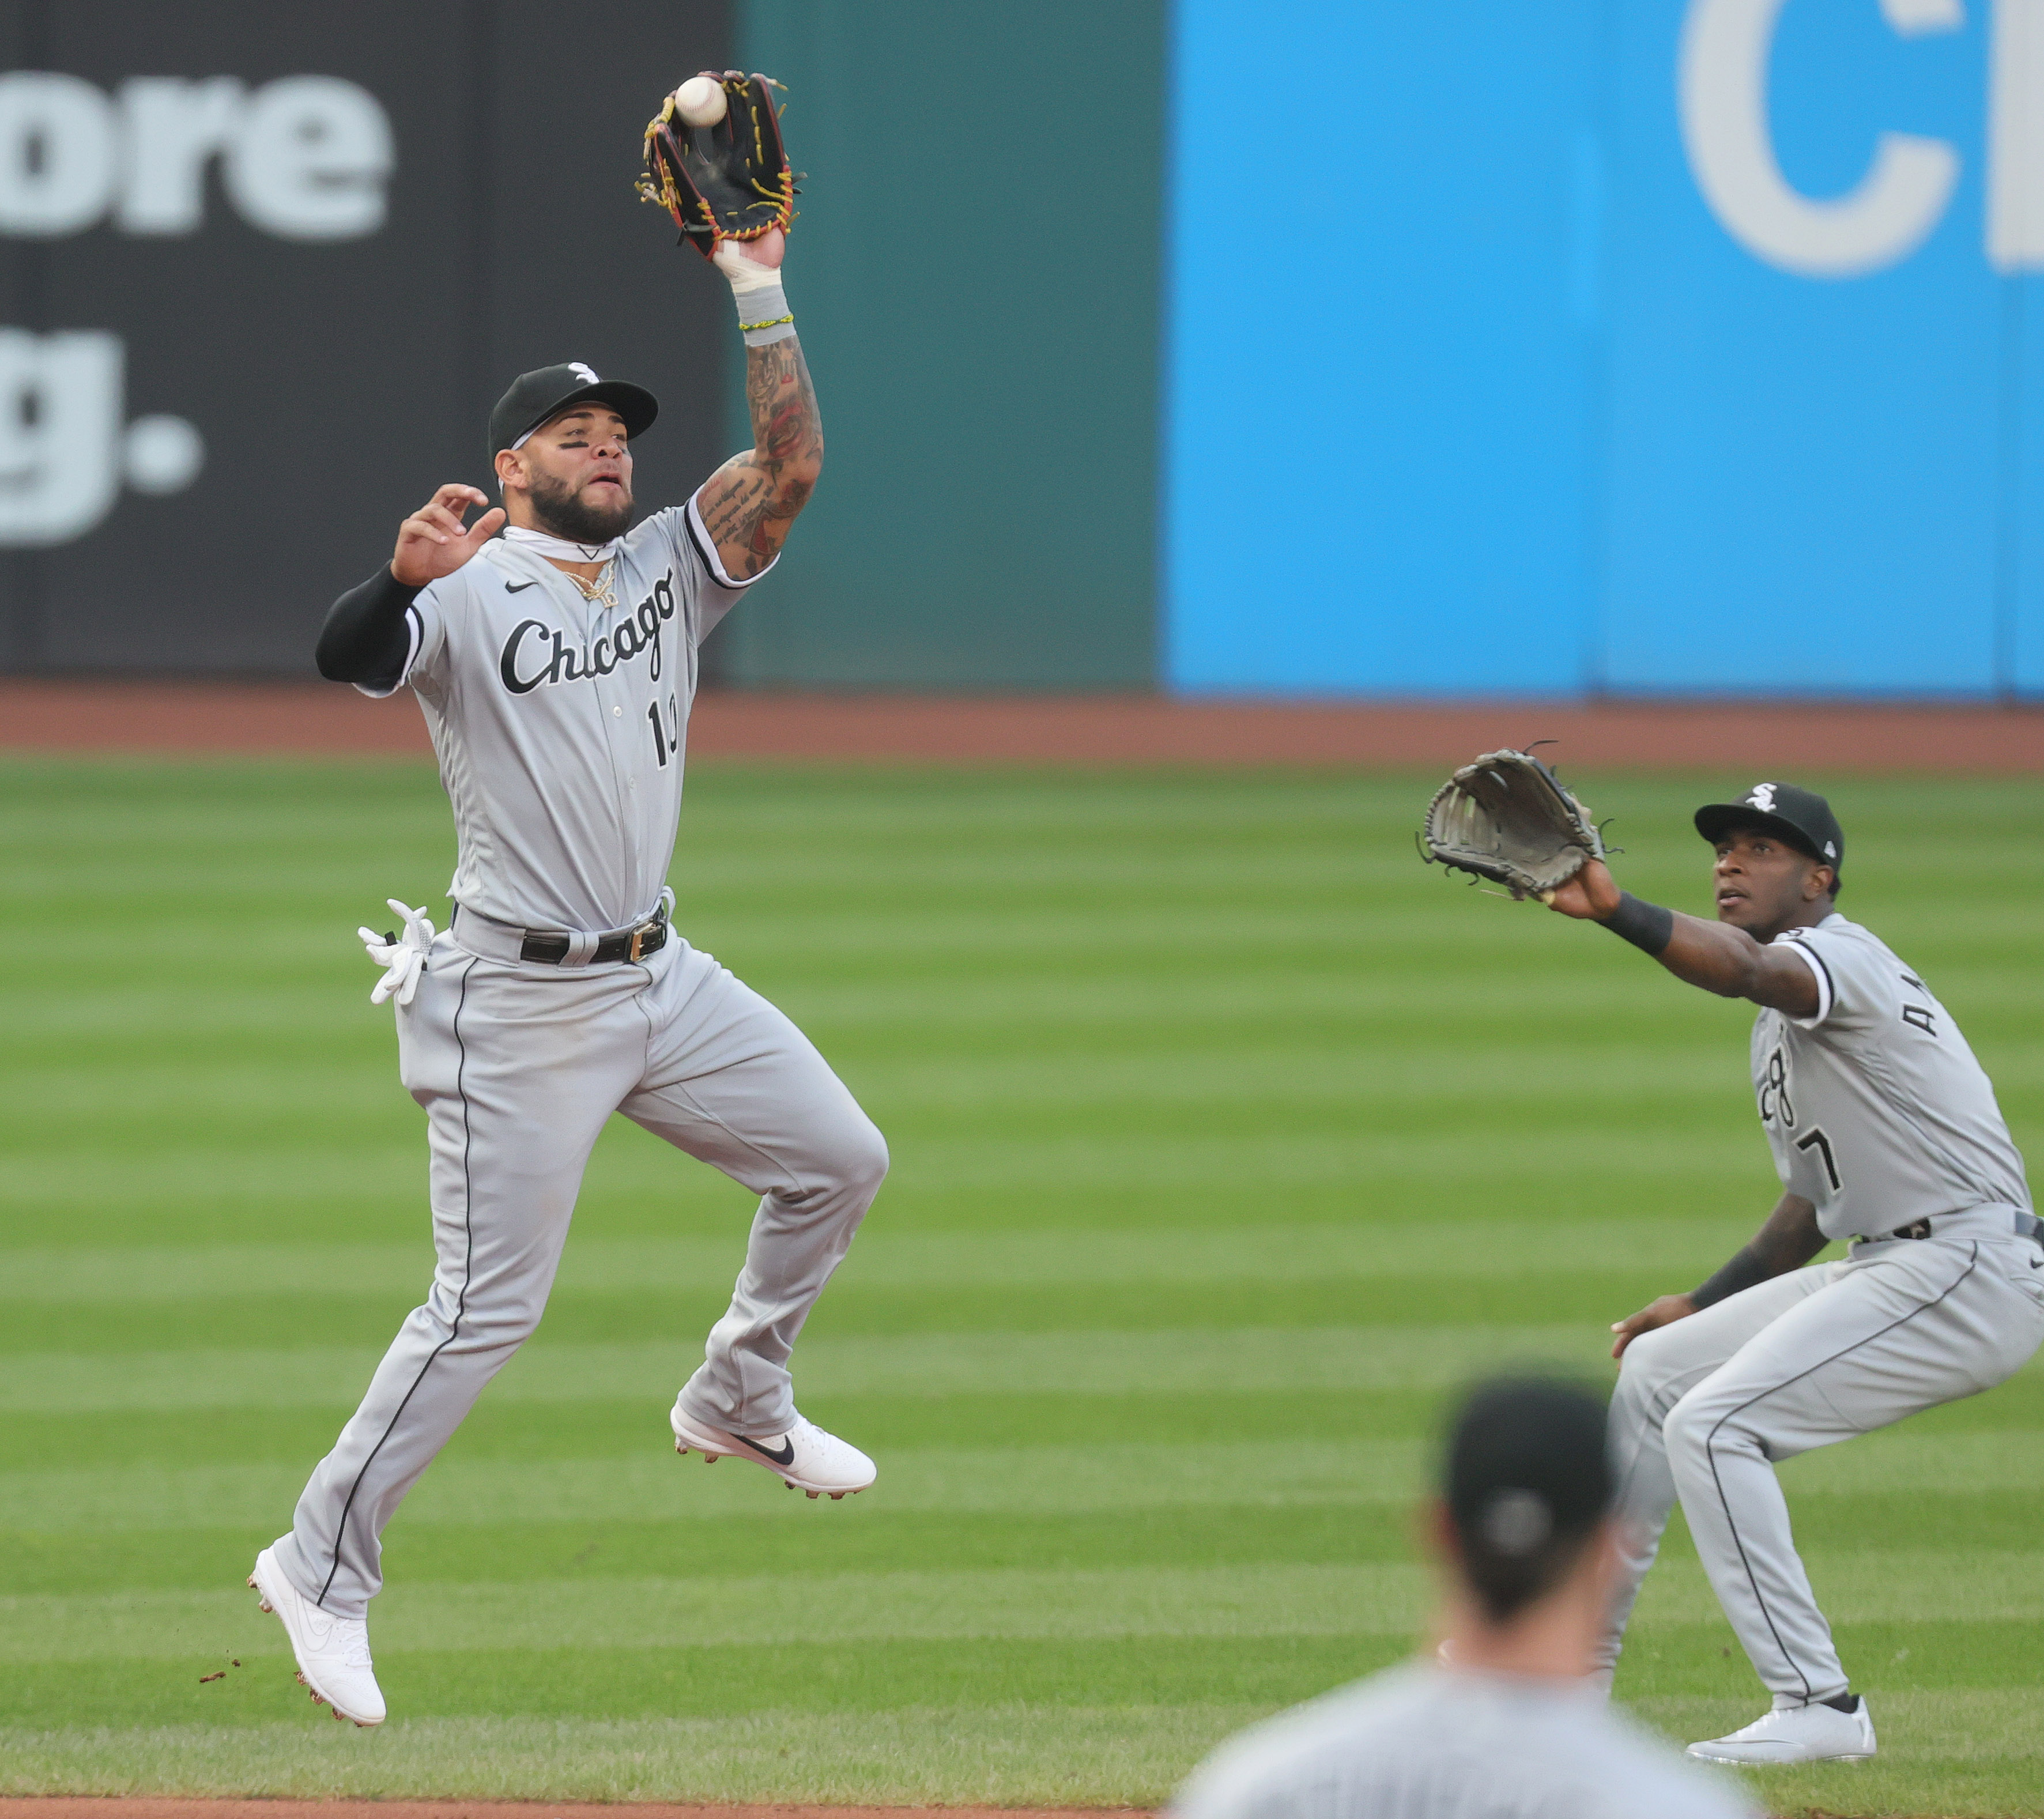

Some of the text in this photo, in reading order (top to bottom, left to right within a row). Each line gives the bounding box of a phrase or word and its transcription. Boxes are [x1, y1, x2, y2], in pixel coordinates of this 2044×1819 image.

[0, 73, 394, 241] ore
[500, 567, 674, 694] Chicago
[1797, 1128, 1841, 1191] 7
